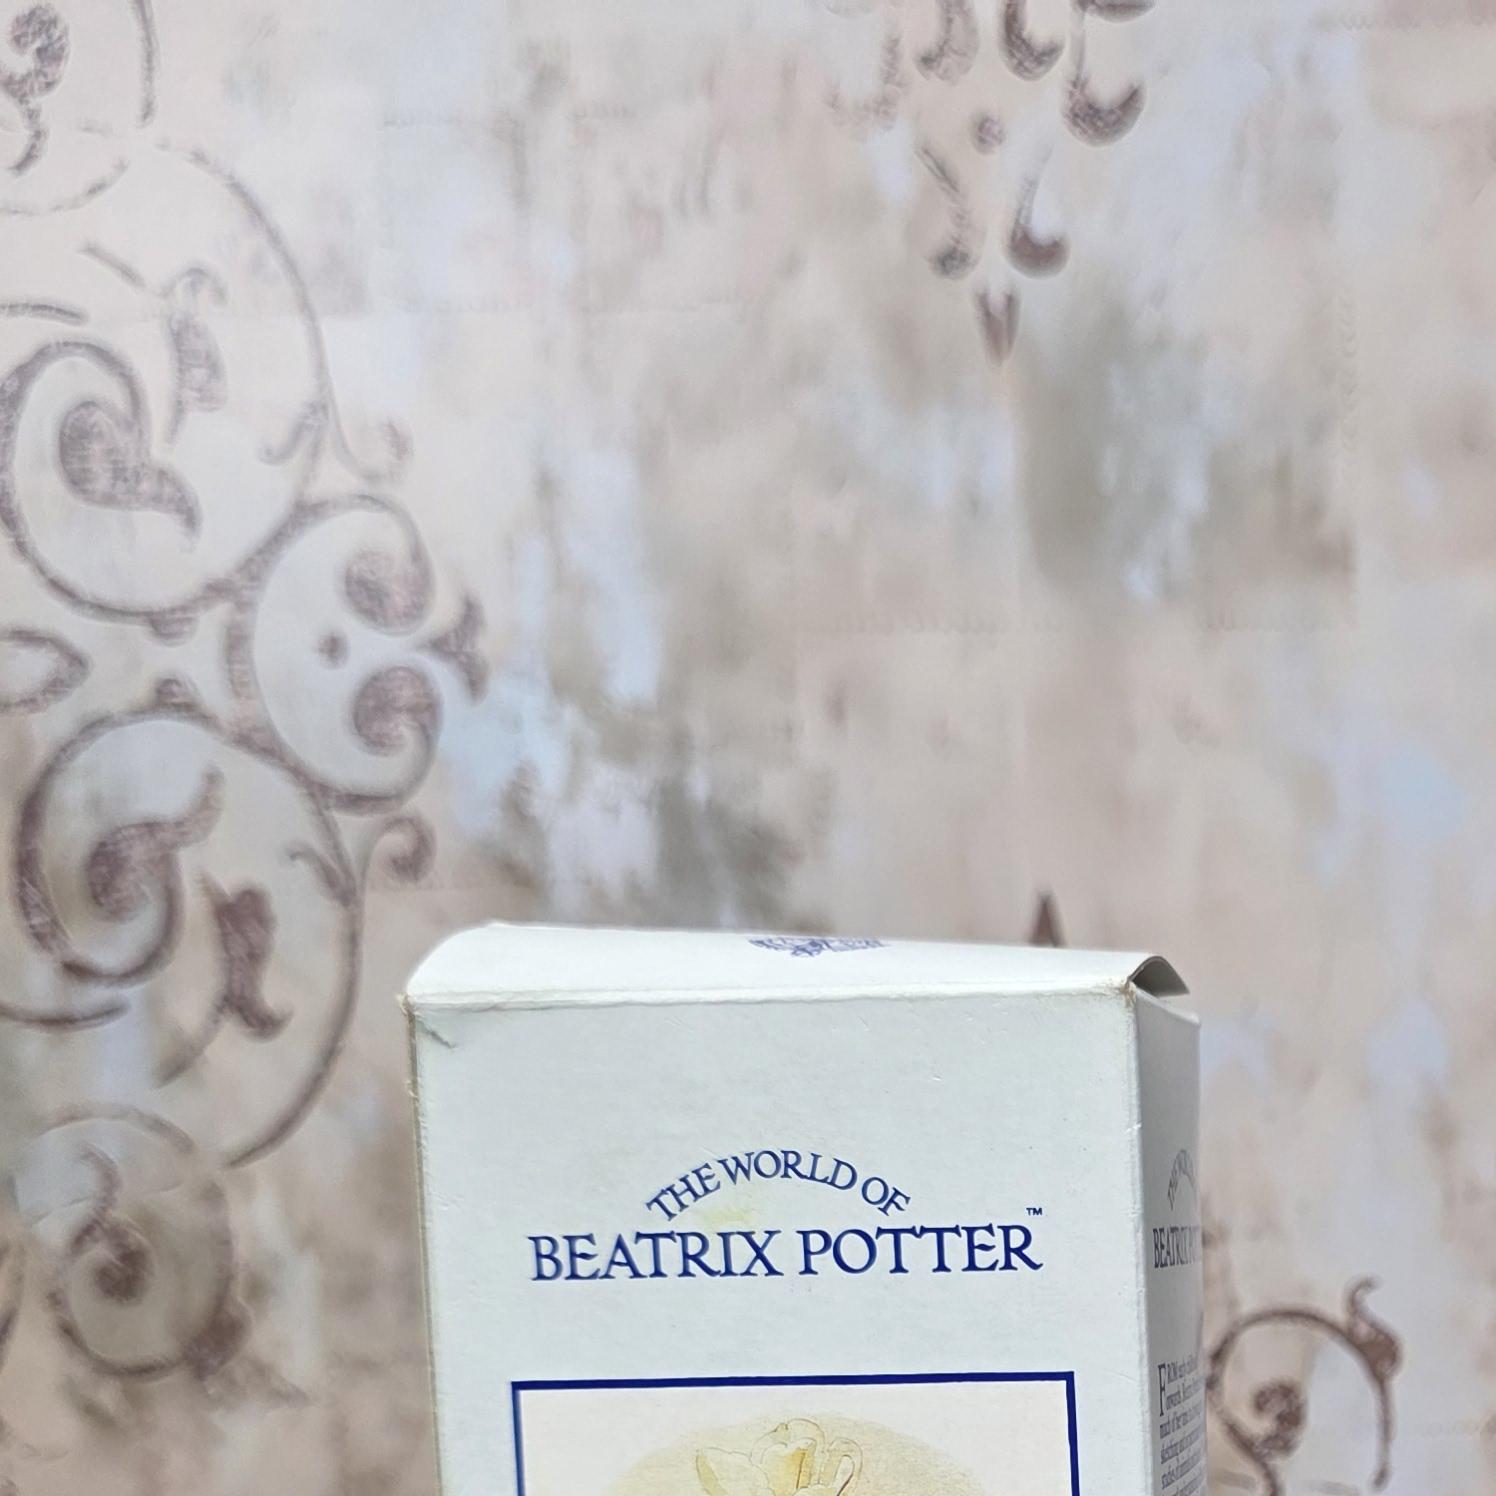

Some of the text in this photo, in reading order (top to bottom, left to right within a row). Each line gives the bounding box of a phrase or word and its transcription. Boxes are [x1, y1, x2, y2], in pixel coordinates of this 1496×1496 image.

[646, 1149, 911, 1222] THE WORLD OF
[527, 1229, 785, 1282] BEATRIX
[796, 1223, 1044, 1276] POTTER
